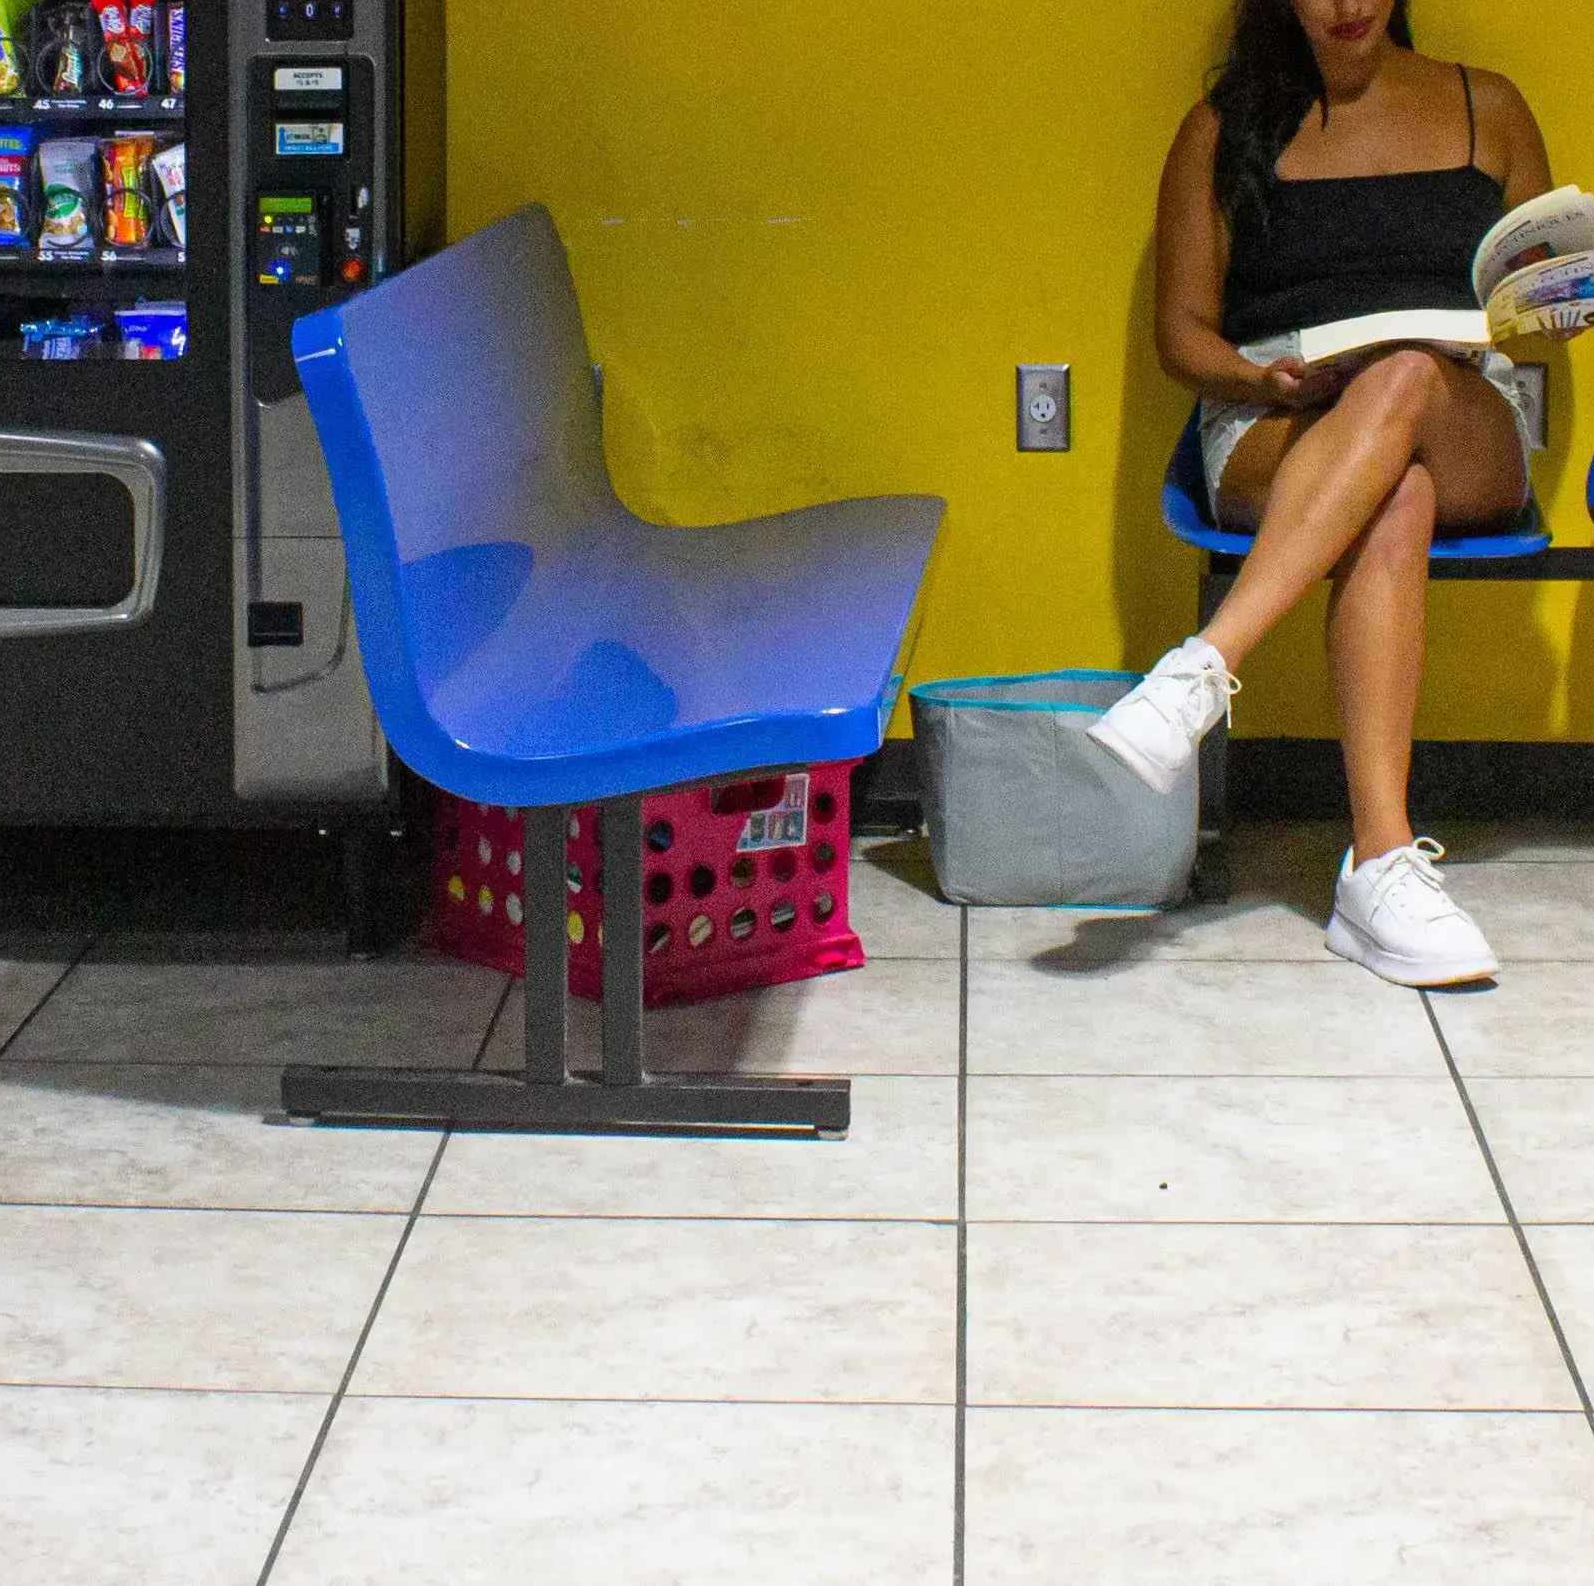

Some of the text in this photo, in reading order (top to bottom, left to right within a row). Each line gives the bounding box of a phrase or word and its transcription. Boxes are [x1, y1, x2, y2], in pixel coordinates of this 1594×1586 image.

[34, 99, 50, 111] 45
[99, 99, 114, 111] 46
[161, 99, 176, 111] 47
[102, 251, 117, 262] 56
